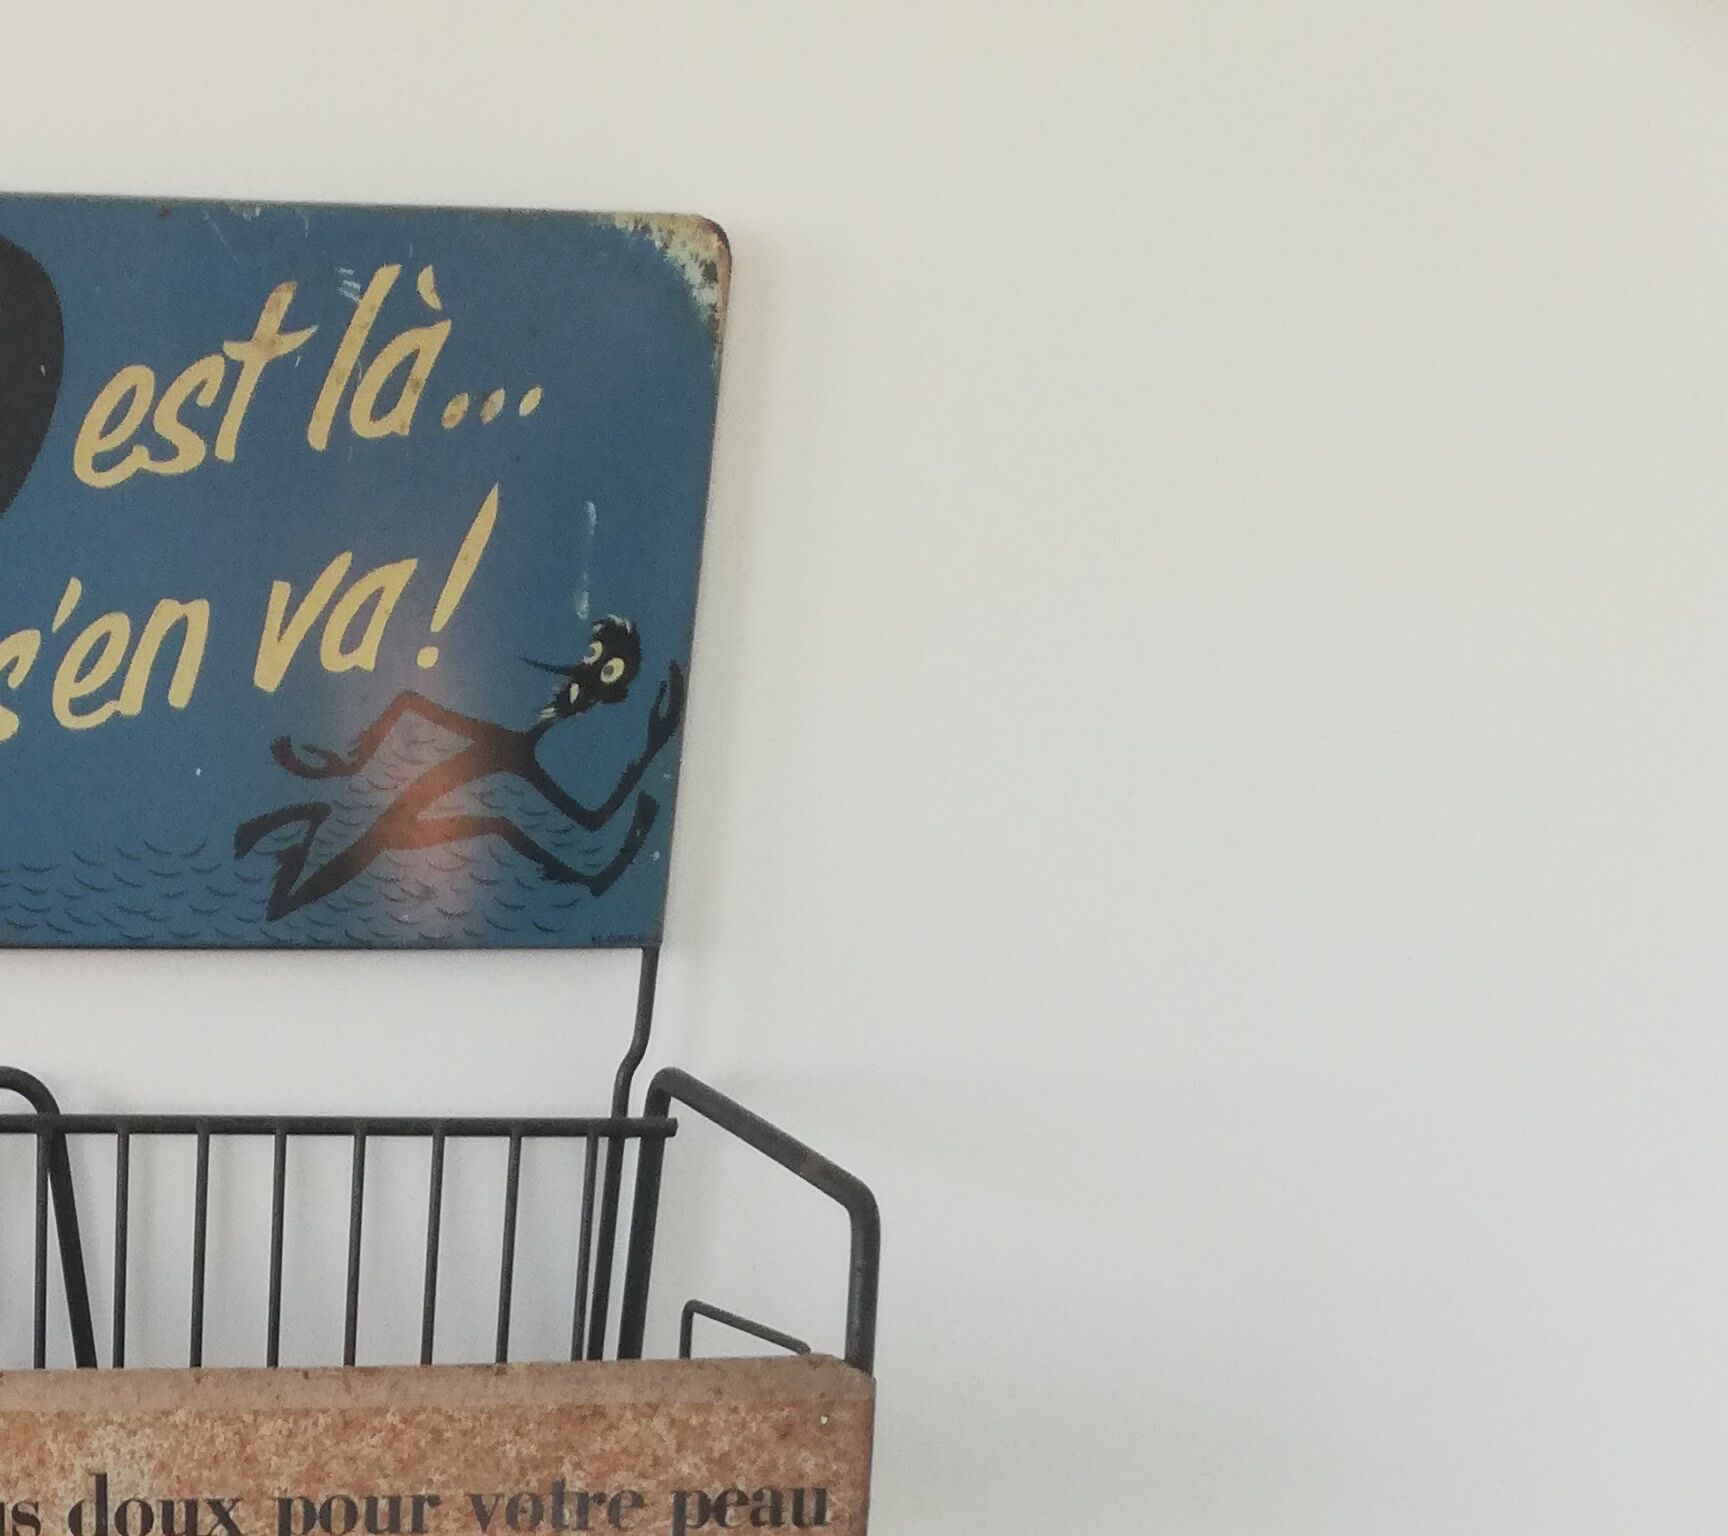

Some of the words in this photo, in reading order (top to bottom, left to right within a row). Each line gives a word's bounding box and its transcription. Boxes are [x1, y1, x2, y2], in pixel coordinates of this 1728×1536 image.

[73, 281, 318, 488] est
[306, 263, 544, 451] là...
[253, 483, 500, 693] va!
[472, 1477, 643, 1535] votre
